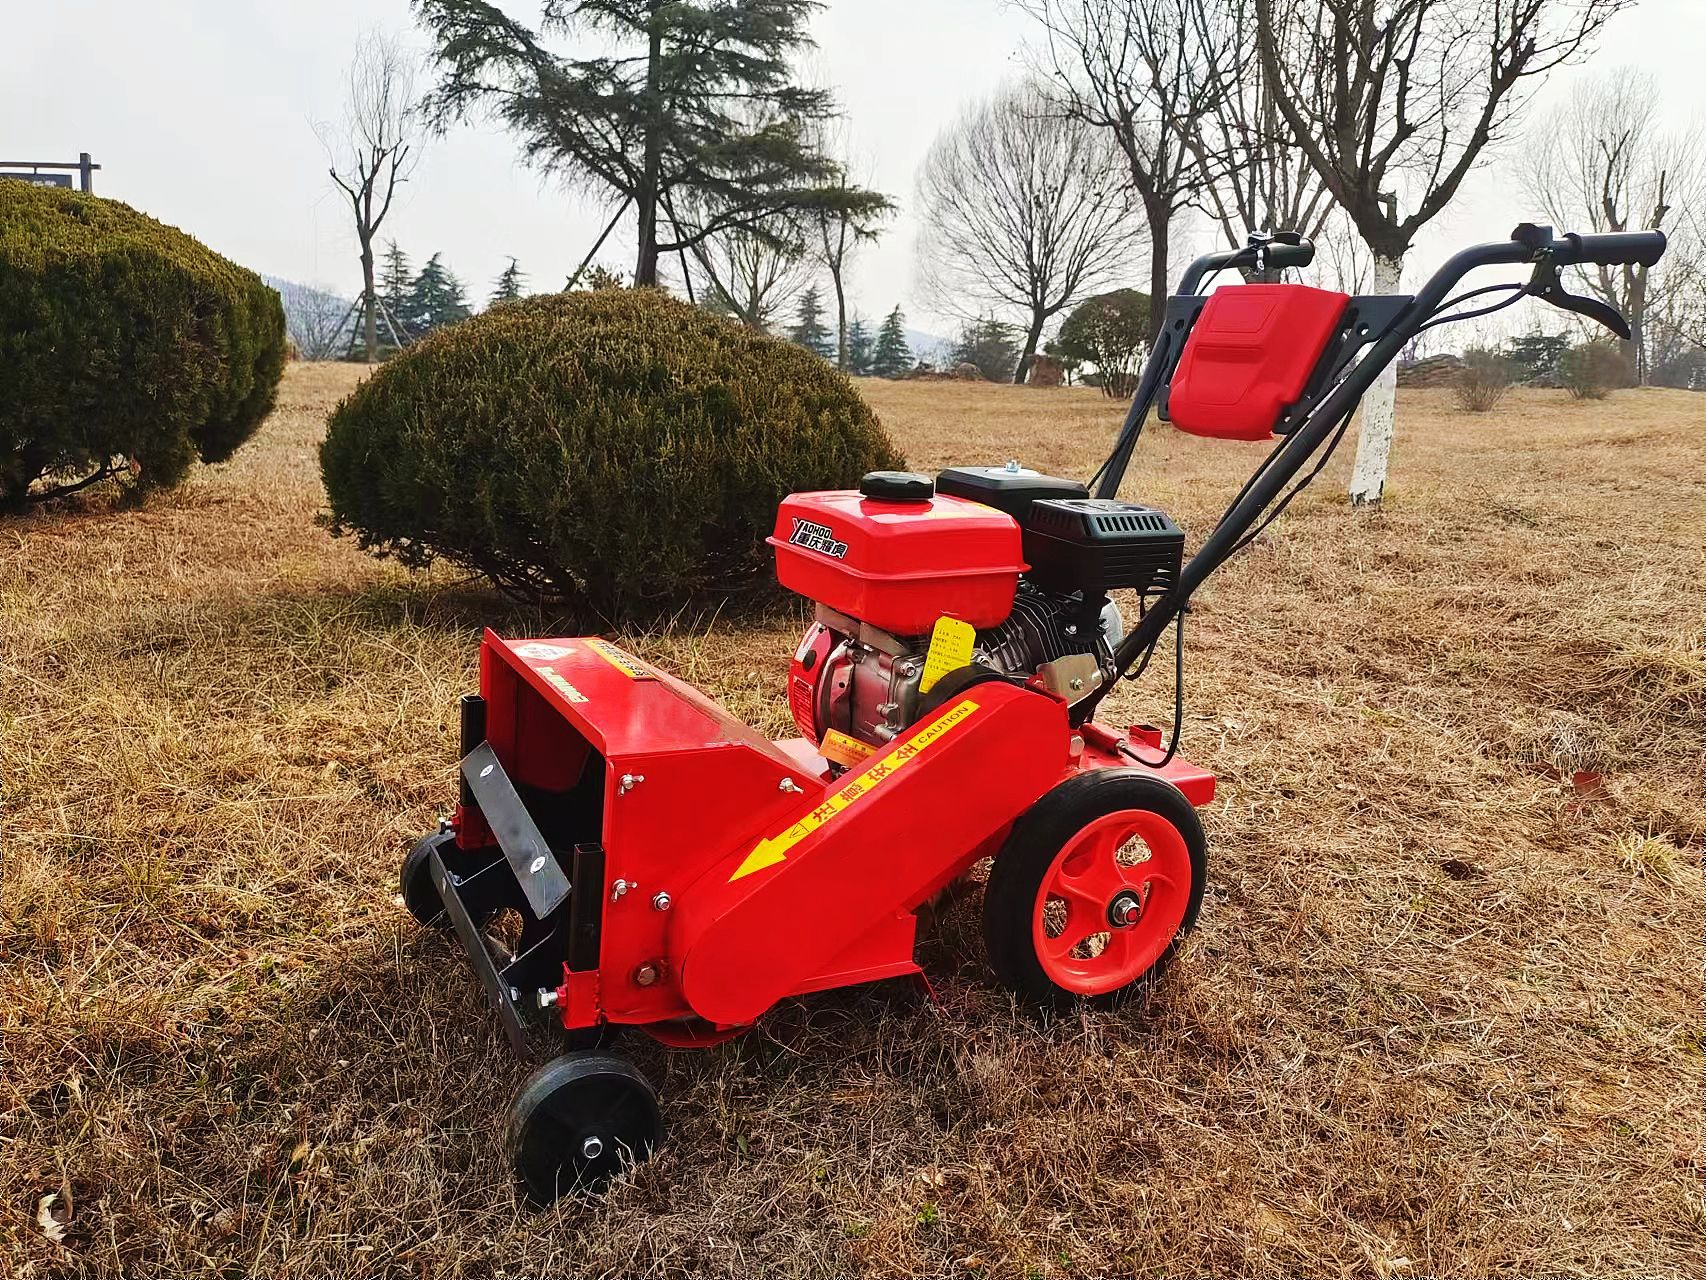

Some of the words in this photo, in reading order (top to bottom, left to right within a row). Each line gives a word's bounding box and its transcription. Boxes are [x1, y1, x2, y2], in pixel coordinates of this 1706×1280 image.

[918, 706, 969, 744] CAUTION
[812, 743, 919, 823] 注意安全
